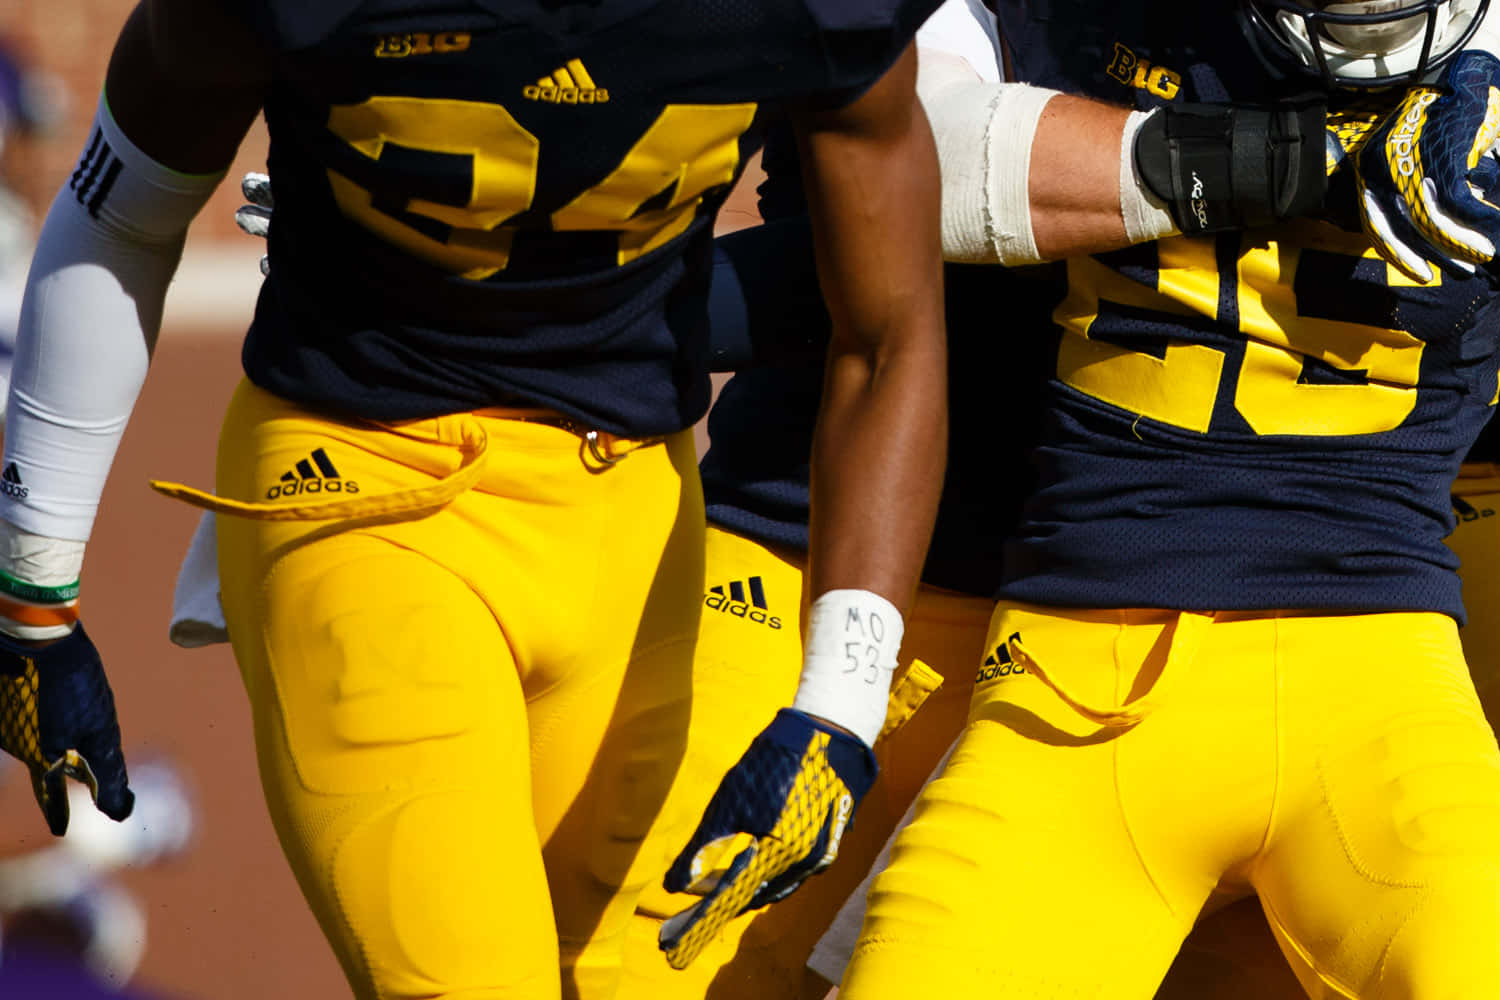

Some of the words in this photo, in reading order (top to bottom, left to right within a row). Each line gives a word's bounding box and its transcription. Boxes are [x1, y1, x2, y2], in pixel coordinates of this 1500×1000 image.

[523, 84, 610, 104] adidas
[267, 478, 360, 500] adidas
[704, 594, 782, 630] didas
